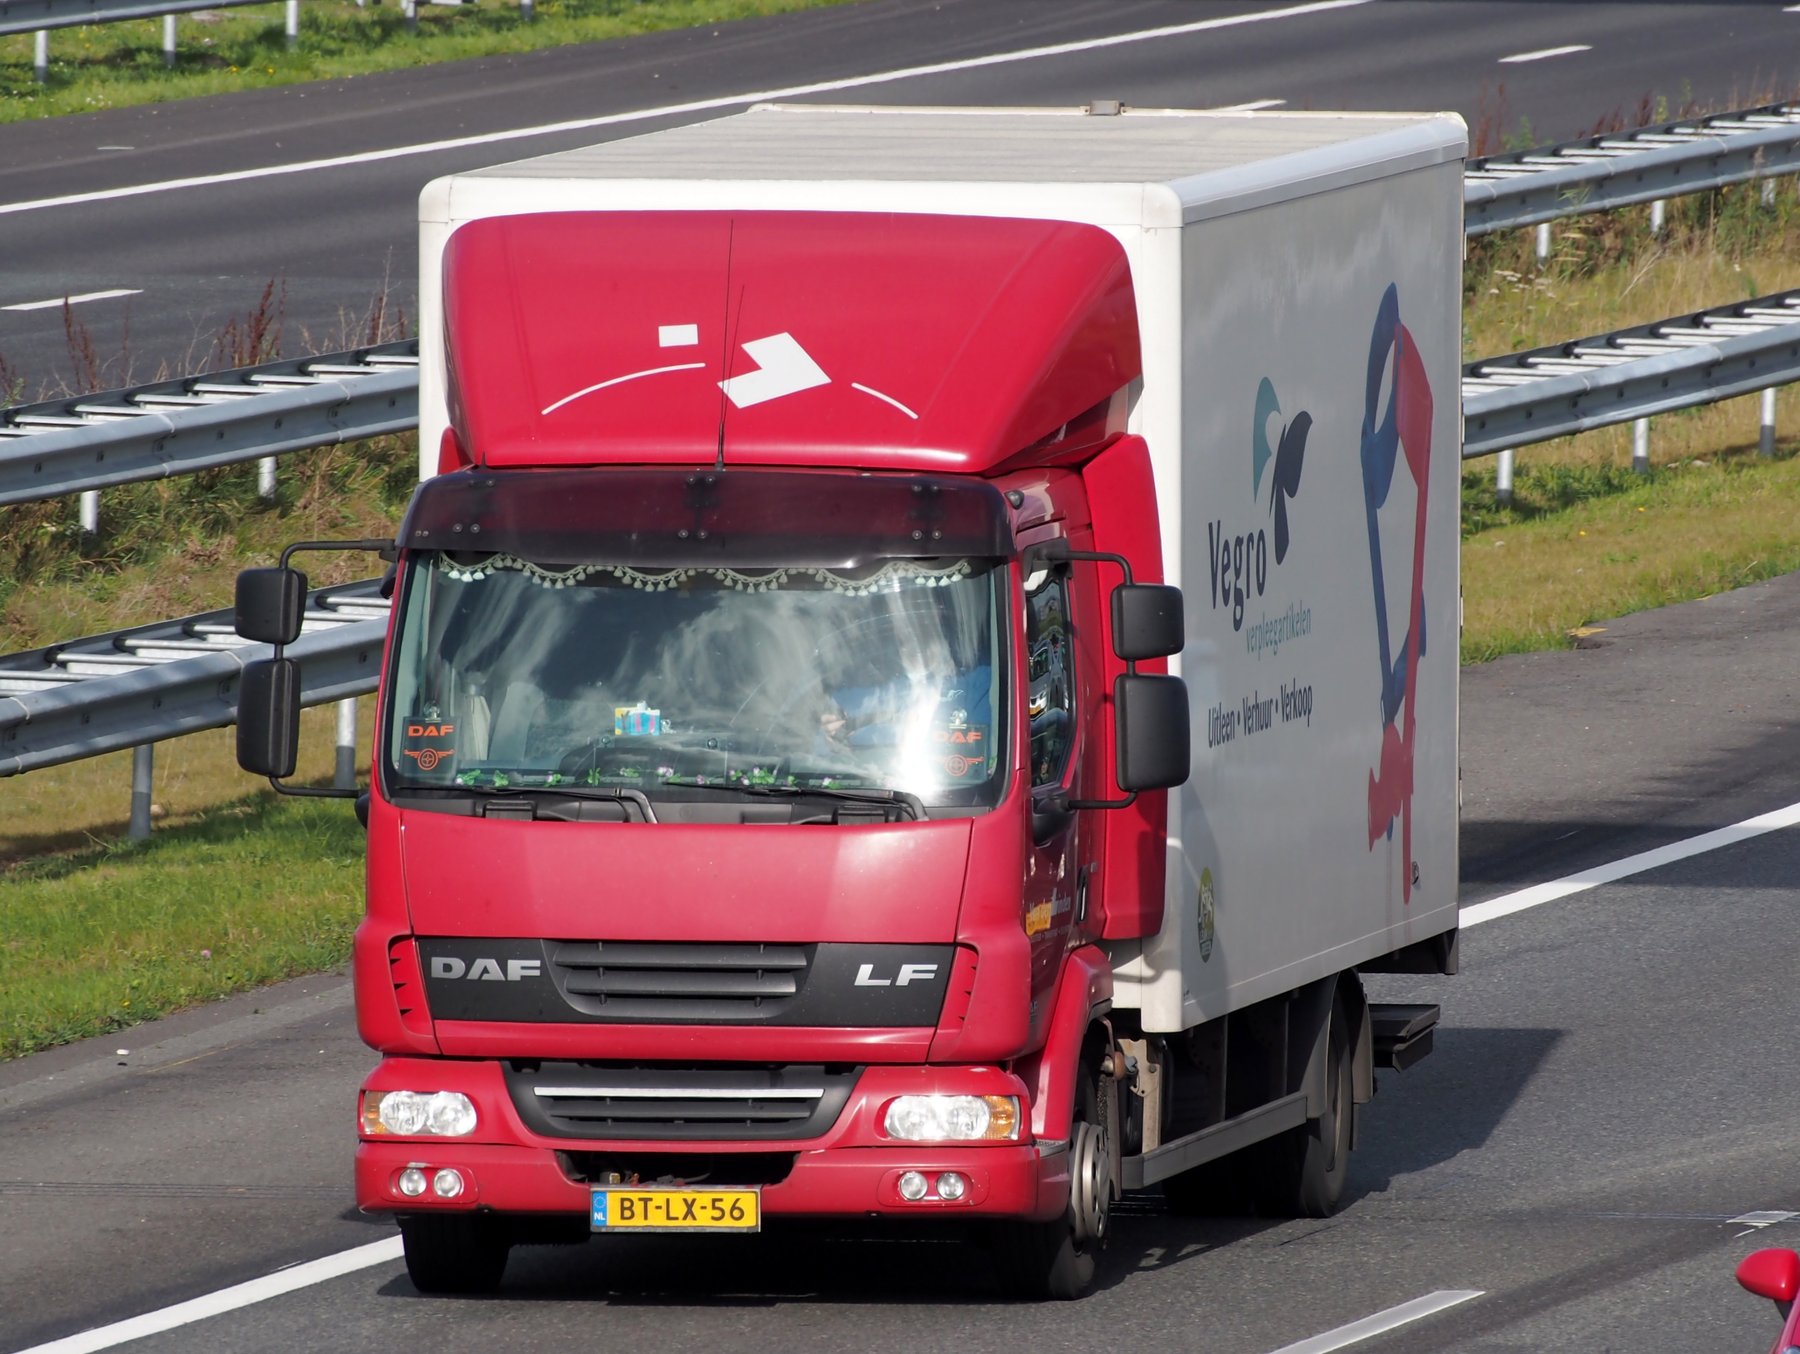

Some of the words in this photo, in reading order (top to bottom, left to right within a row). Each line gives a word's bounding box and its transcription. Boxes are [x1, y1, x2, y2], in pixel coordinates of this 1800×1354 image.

[1208, 519, 1267, 632] Vegro
[1246, 600, 1312, 661] verpleegartikelen
[1208, 702, 1235, 748] Uitleen
[1242, 690, 1274, 736] Verhuur
[1280, 677, 1313, 728] Verkoop
[408, 725, 455, 737] DAF
[431, 957, 541, 981] DAF
[854, 964, 938, 986] LF
[594, 1212, 606, 1221] NL
[620, 1197, 745, 1222] BT-LX-56
